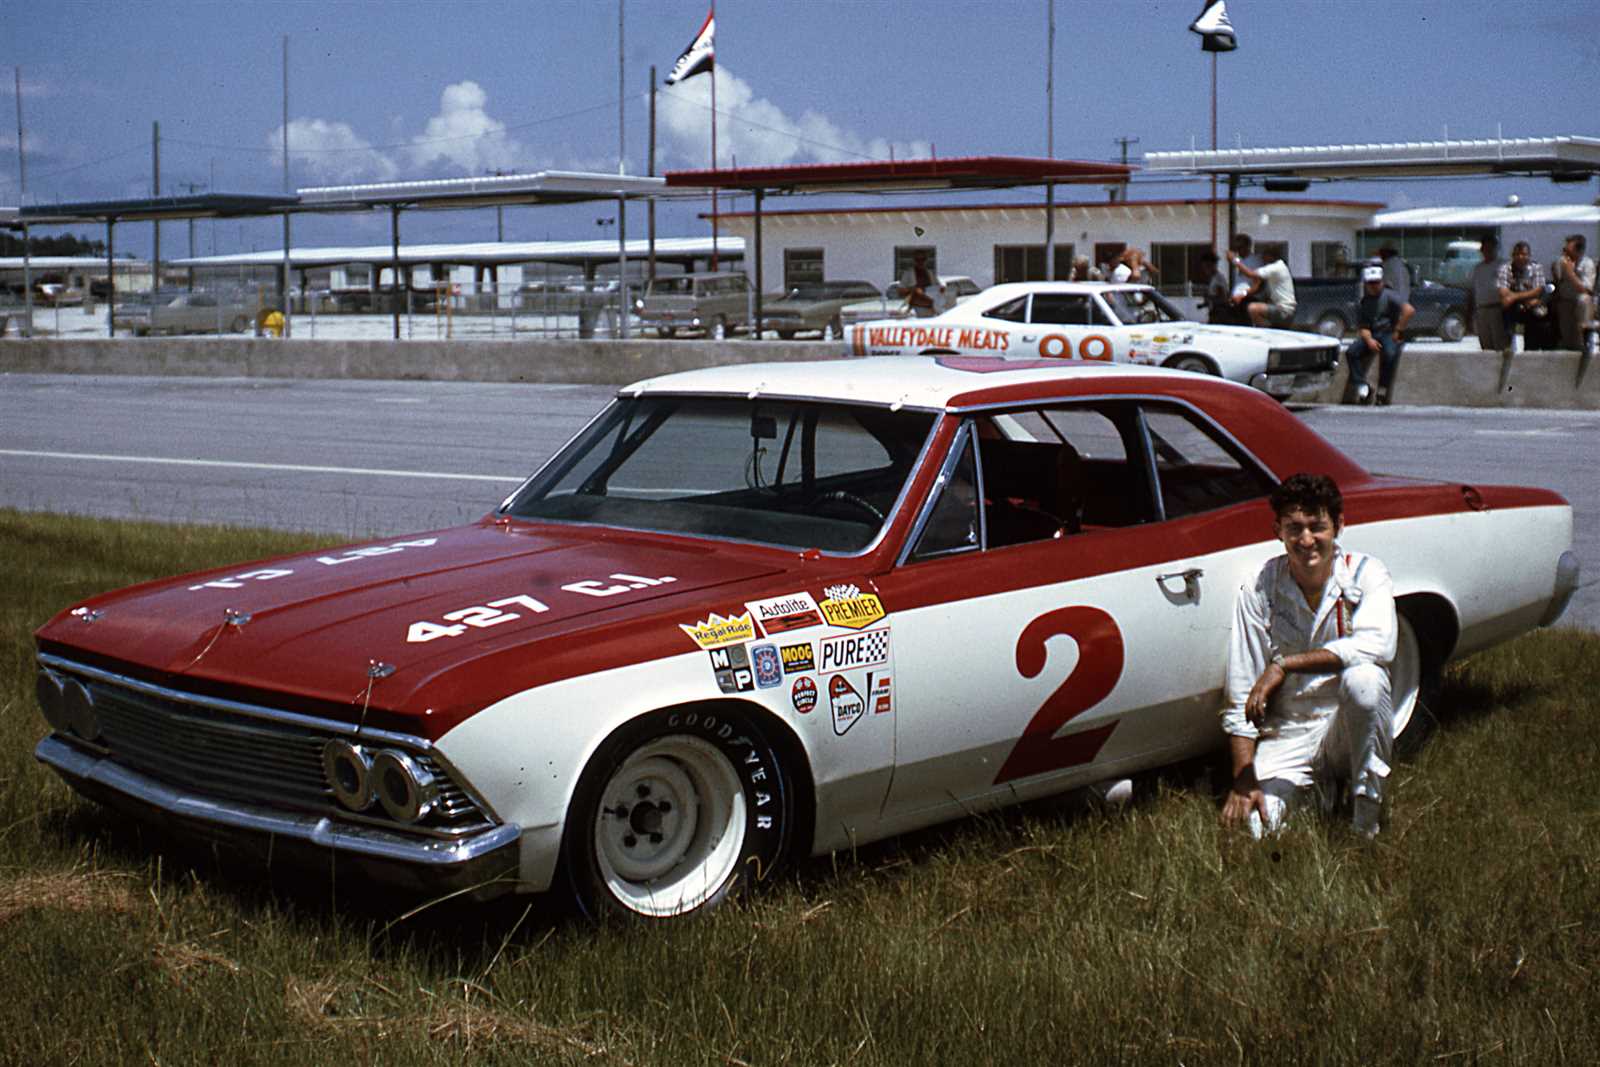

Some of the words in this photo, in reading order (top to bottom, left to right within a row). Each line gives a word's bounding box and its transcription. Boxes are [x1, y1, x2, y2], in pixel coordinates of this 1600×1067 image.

[869, 327, 954, 347] VALLEYDALE
[958, 329, 1010, 351] MEATS
[406, 594, 550, 643] 427
[561, 573, 679, 597] C.I.
[759, 599, 810, 618] Autolite
[825, 598, 881, 621] PREMIER
[694, 625, 726, 641] Regal
[726, 621, 752, 634] Ride
[781, 644, 813, 662] MOOG
[822, 636, 865, 669] PURE
[992, 605, 1124, 785] 2
[837, 702, 861, 717] DAYCO
[667, 713, 773, 830] GOODYEAR
